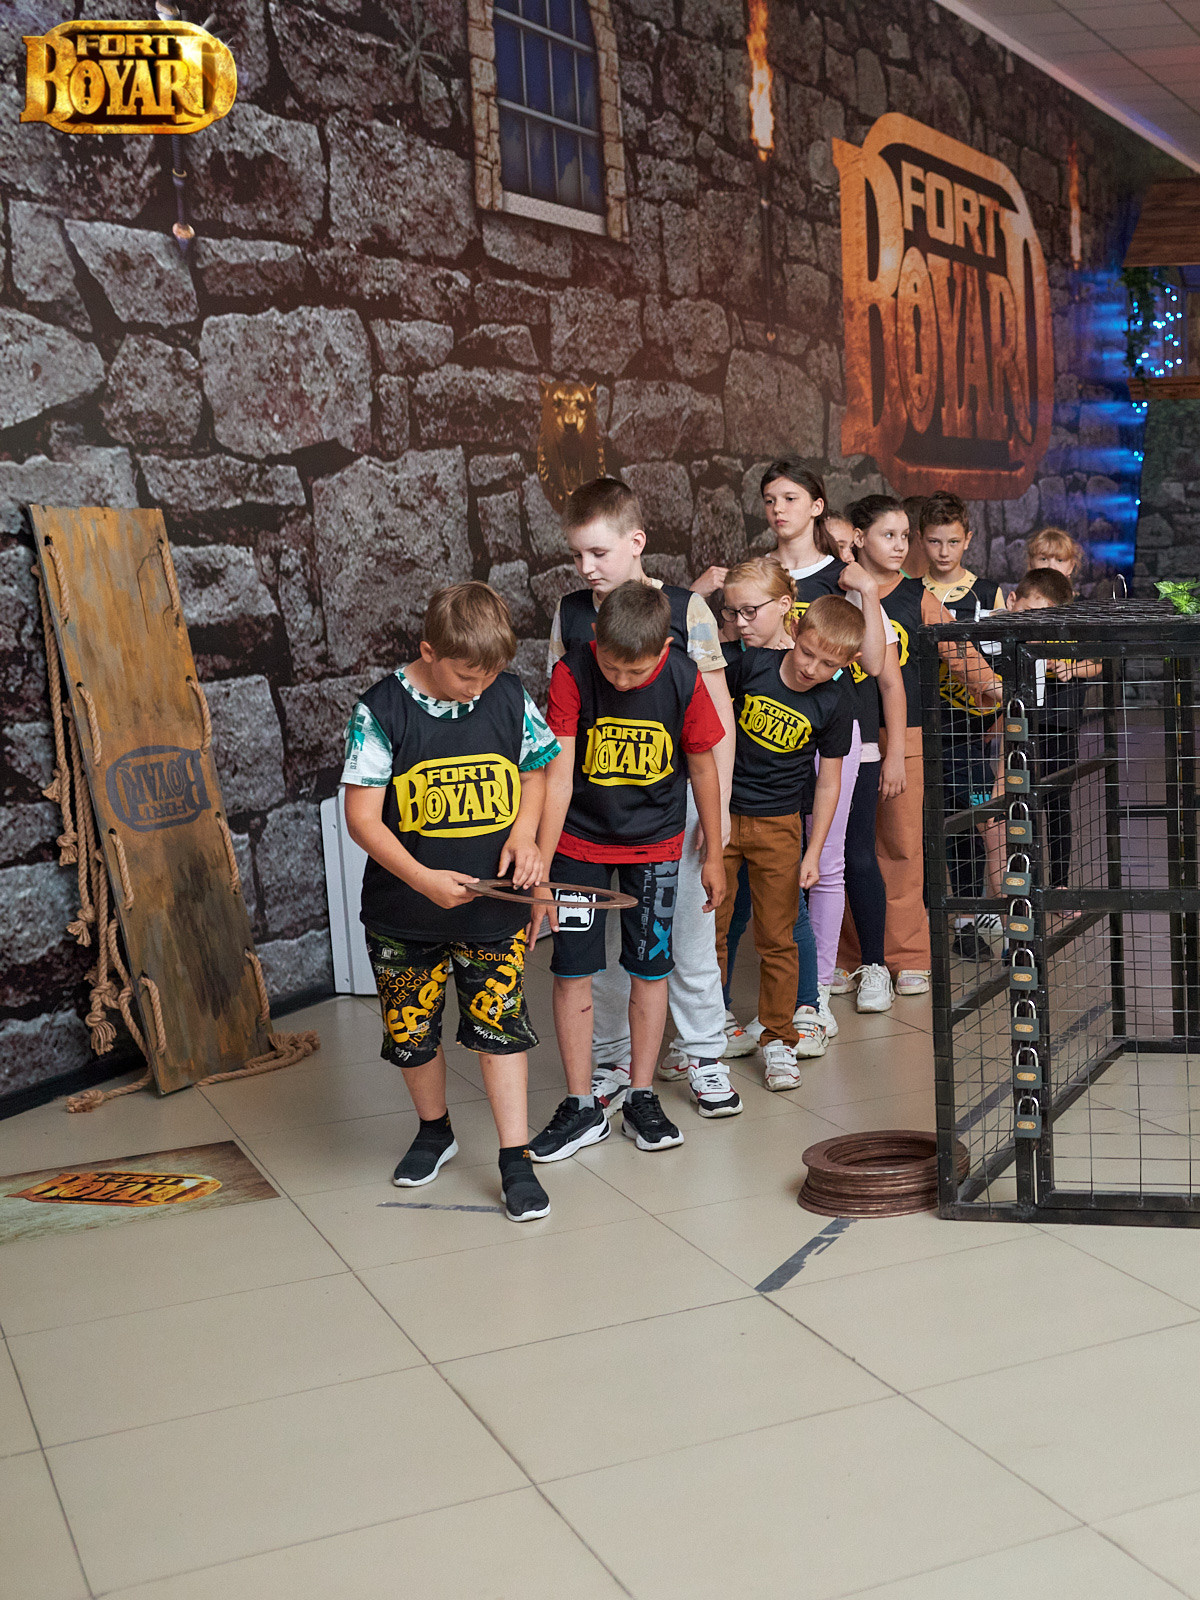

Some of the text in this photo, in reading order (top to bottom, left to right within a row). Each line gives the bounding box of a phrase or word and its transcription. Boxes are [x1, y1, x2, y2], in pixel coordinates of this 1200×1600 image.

[902, 161, 998, 258] FORT
[832, 137, 1054, 460] BOYARD
[738, 693, 812, 750] BOYARD
[760, 702, 798, 724] FORT
[582, 728, 674, 779] BOYARD
[106, 748, 212, 822] BOYARD
[427, 764, 490, 785] FORT
[141, 800, 187, 820] FORT
[393, 763, 521, 832] BOYARD
[477, 949, 506, 962] Sour
[388, 966, 416, 993] Sour
[391, 969, 429, 1008] Just Sour
[4, 1172, 222, 1205] BOYARD
[94, 1174, 184, 1185] FORT
